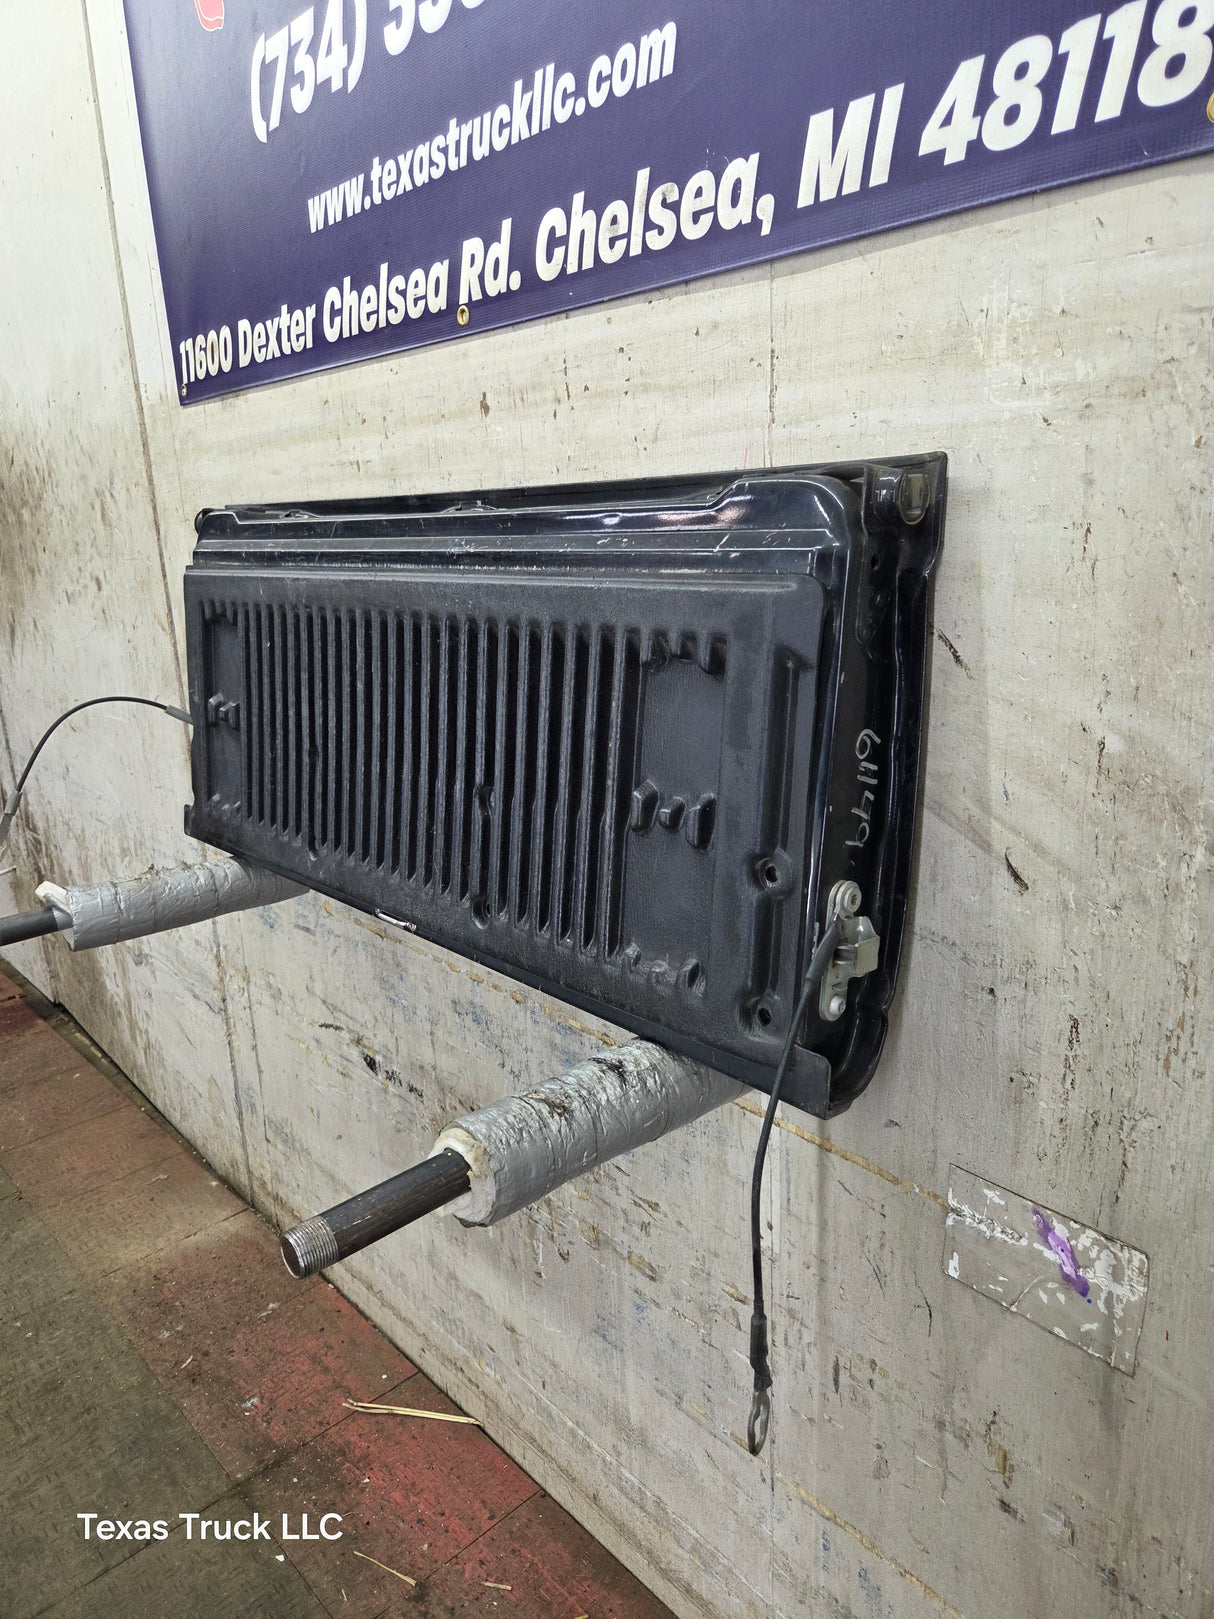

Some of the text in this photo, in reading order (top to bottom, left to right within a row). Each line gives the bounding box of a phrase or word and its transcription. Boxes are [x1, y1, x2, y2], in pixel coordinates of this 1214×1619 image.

[251, 0, 368, 143] (734)
[307, 21, 677, 233] www.texastruckllc.com
[179, 0, 1214, 384] 11600 Dexter Chelsea Rd. Chelsea, MI 48118
